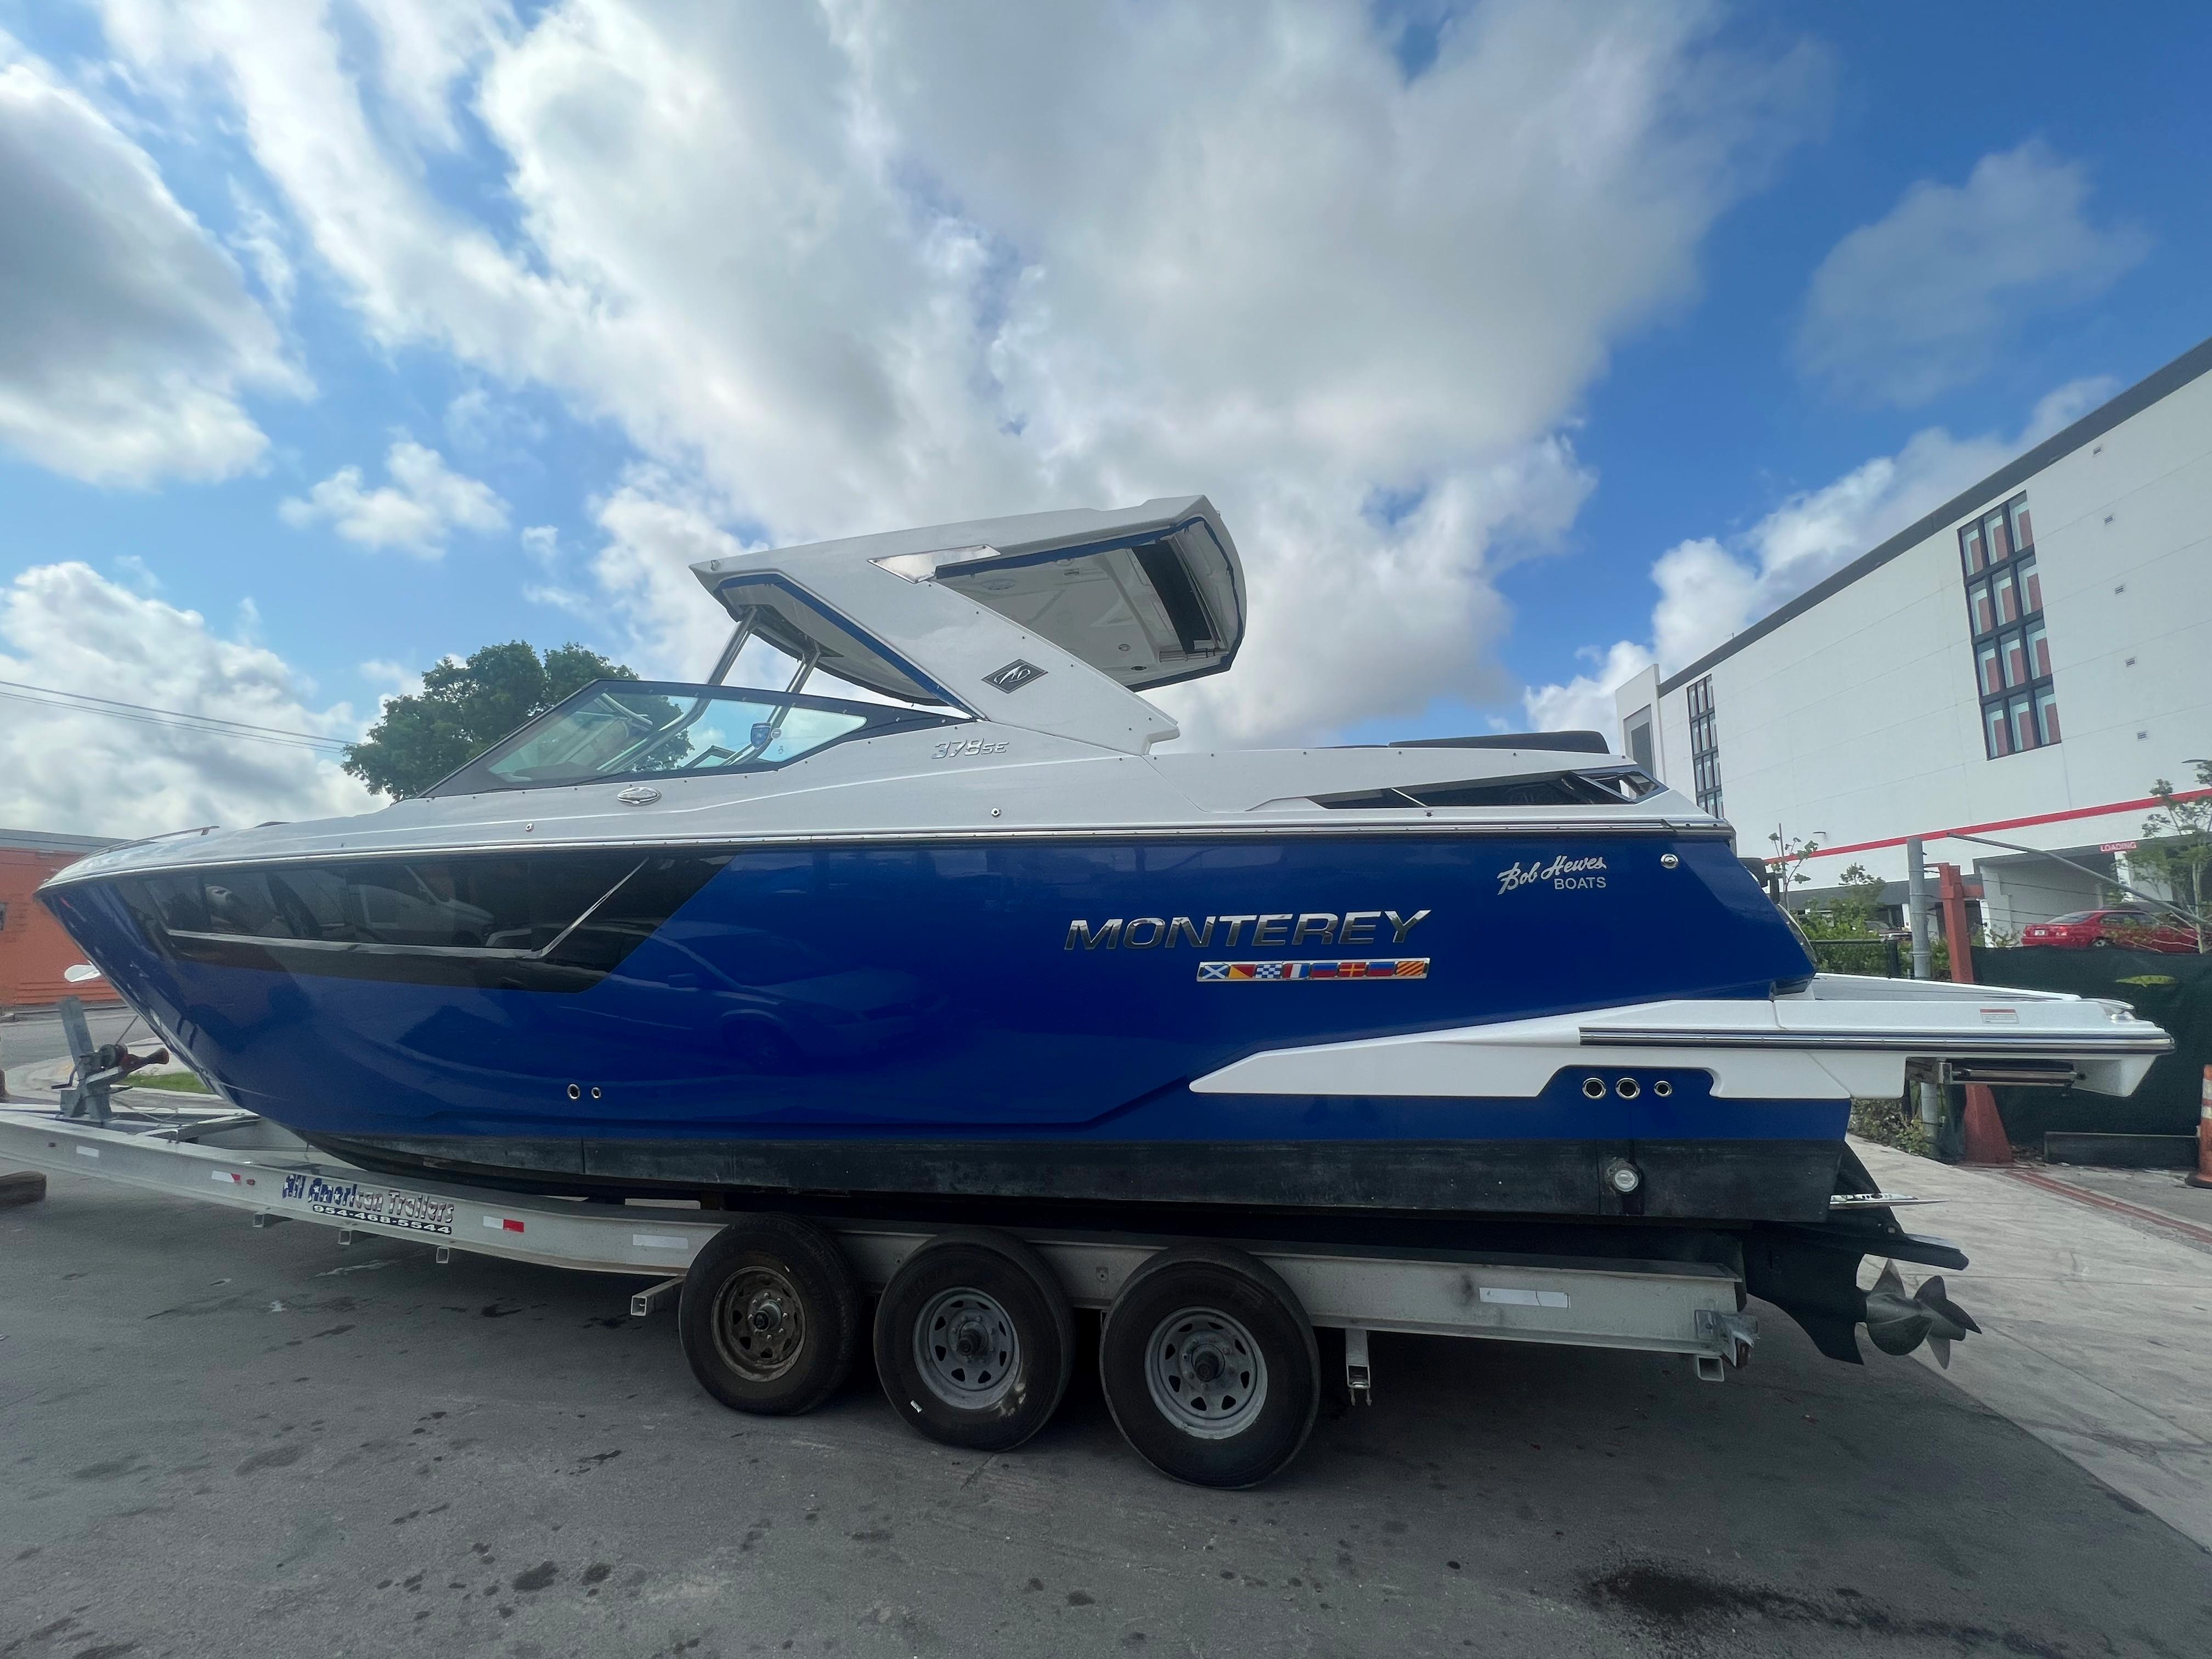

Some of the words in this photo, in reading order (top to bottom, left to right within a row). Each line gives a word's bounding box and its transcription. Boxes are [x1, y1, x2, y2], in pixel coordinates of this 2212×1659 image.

[932, 738, 1009, 759] 378SE
[2100, 842, 2137, 852] LOADING
[1497, 862, 1541, 895] Bob
[1540, 855, 1607, 880] Hewes
[1554, 876, 1607, 890] BOATS
[1064, 909, 1432, 950] MONTEREY
[282, 1173, 307, 1199] All
[307, 1177, 383, 1212] American
[388, 1189, 454, 1223] Trailers
[313, 1205, 451, 1234] 954-468-5544
